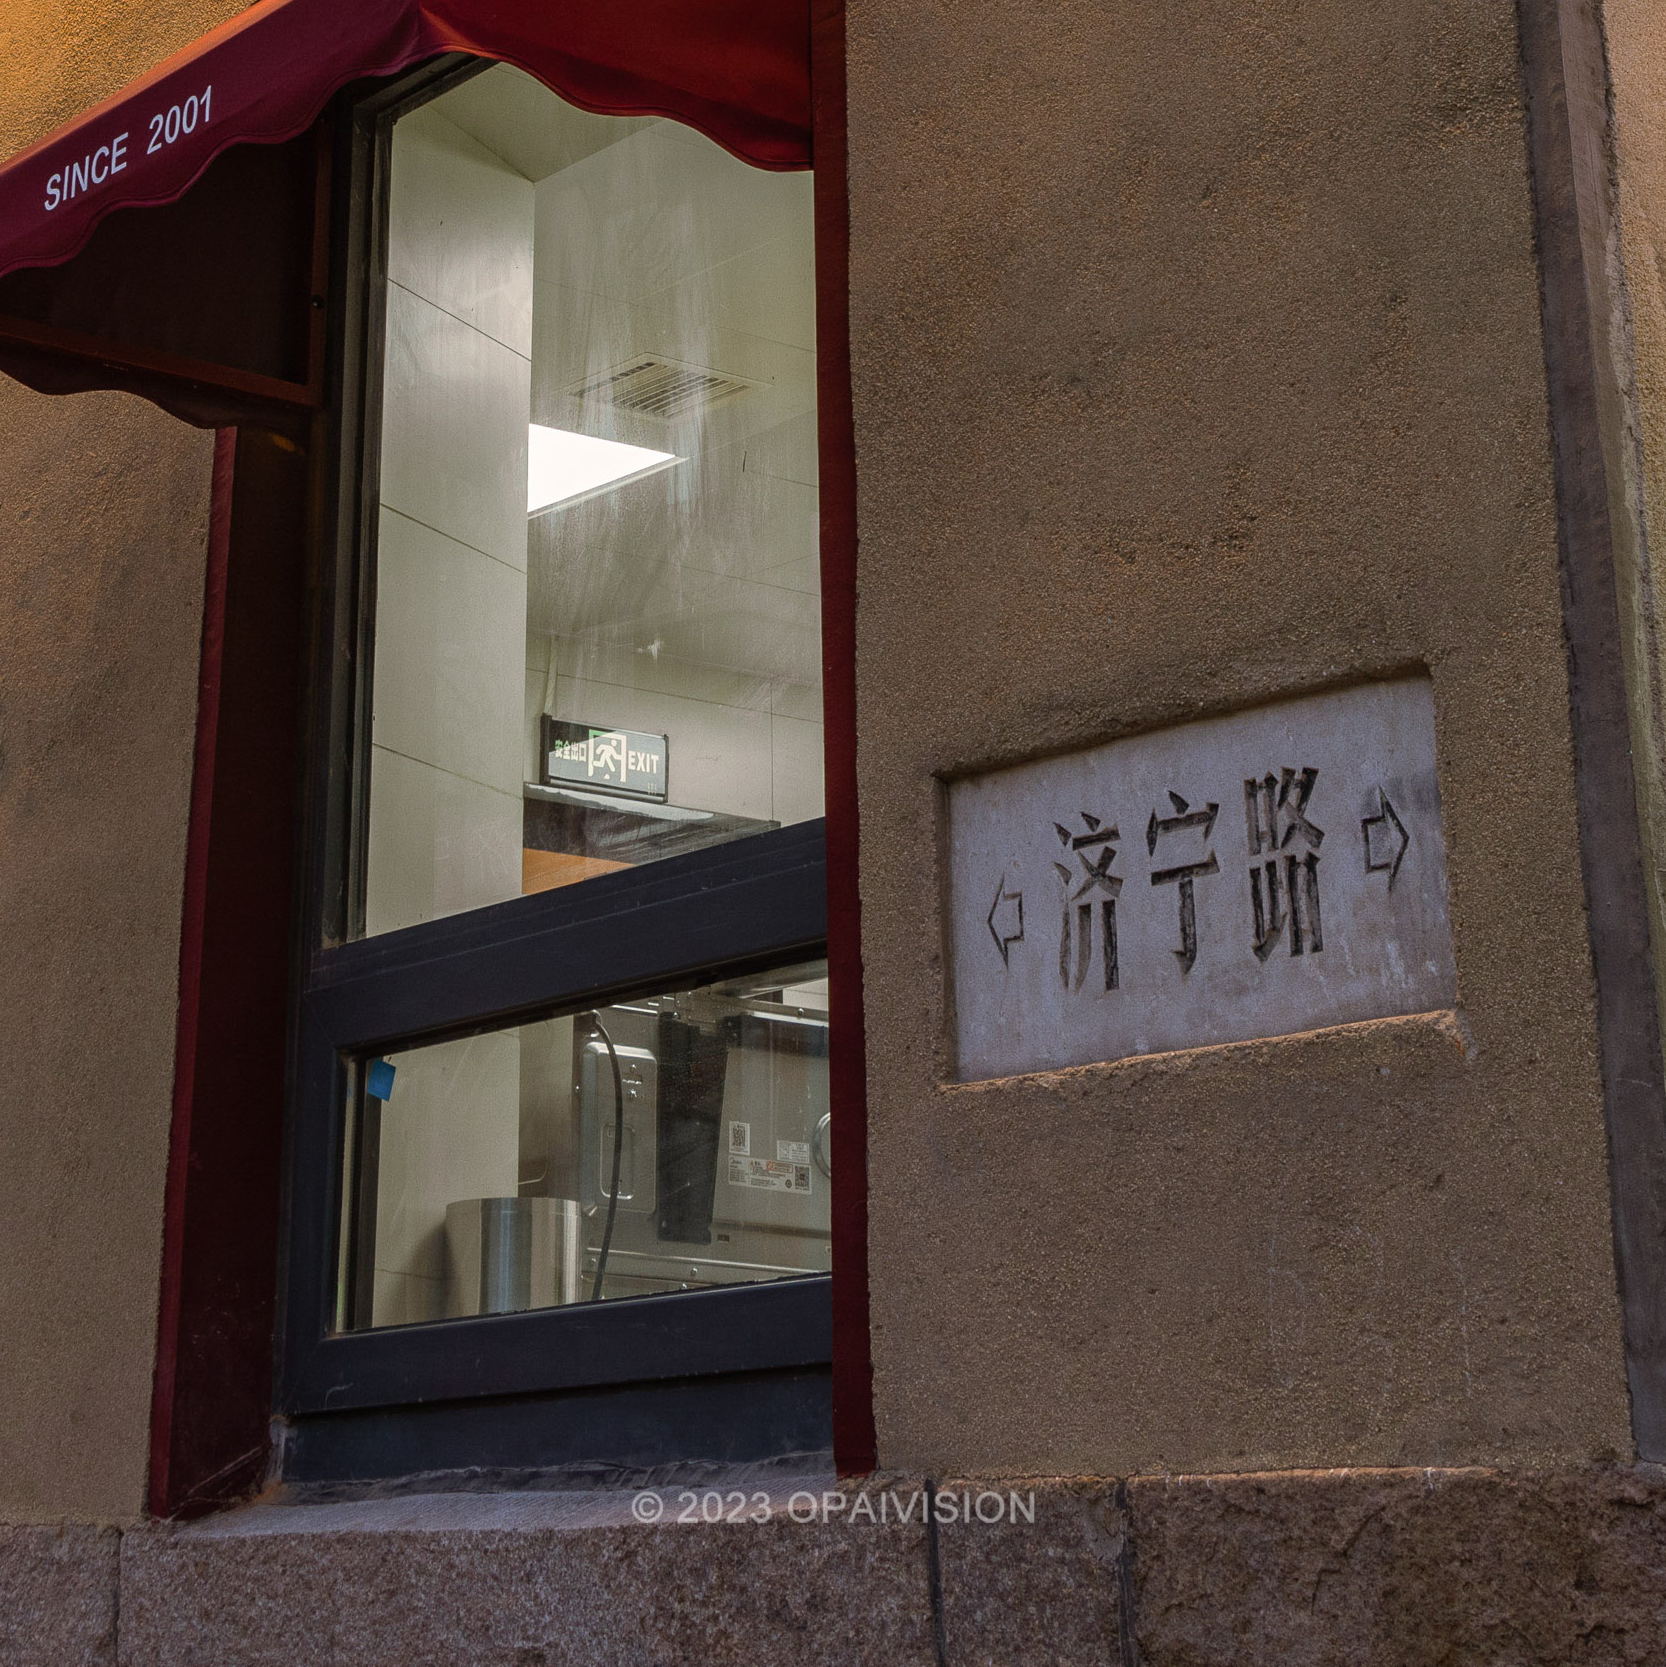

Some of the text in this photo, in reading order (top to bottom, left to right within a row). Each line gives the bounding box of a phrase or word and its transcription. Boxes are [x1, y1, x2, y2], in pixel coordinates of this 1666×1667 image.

[44, 85, 212, 211] SINCE 2001
[555, 739, 587, 763] 安全出口
[628, 750, 660, 774] EXIT
[1053, 765, 1325, 993] 济宁路
